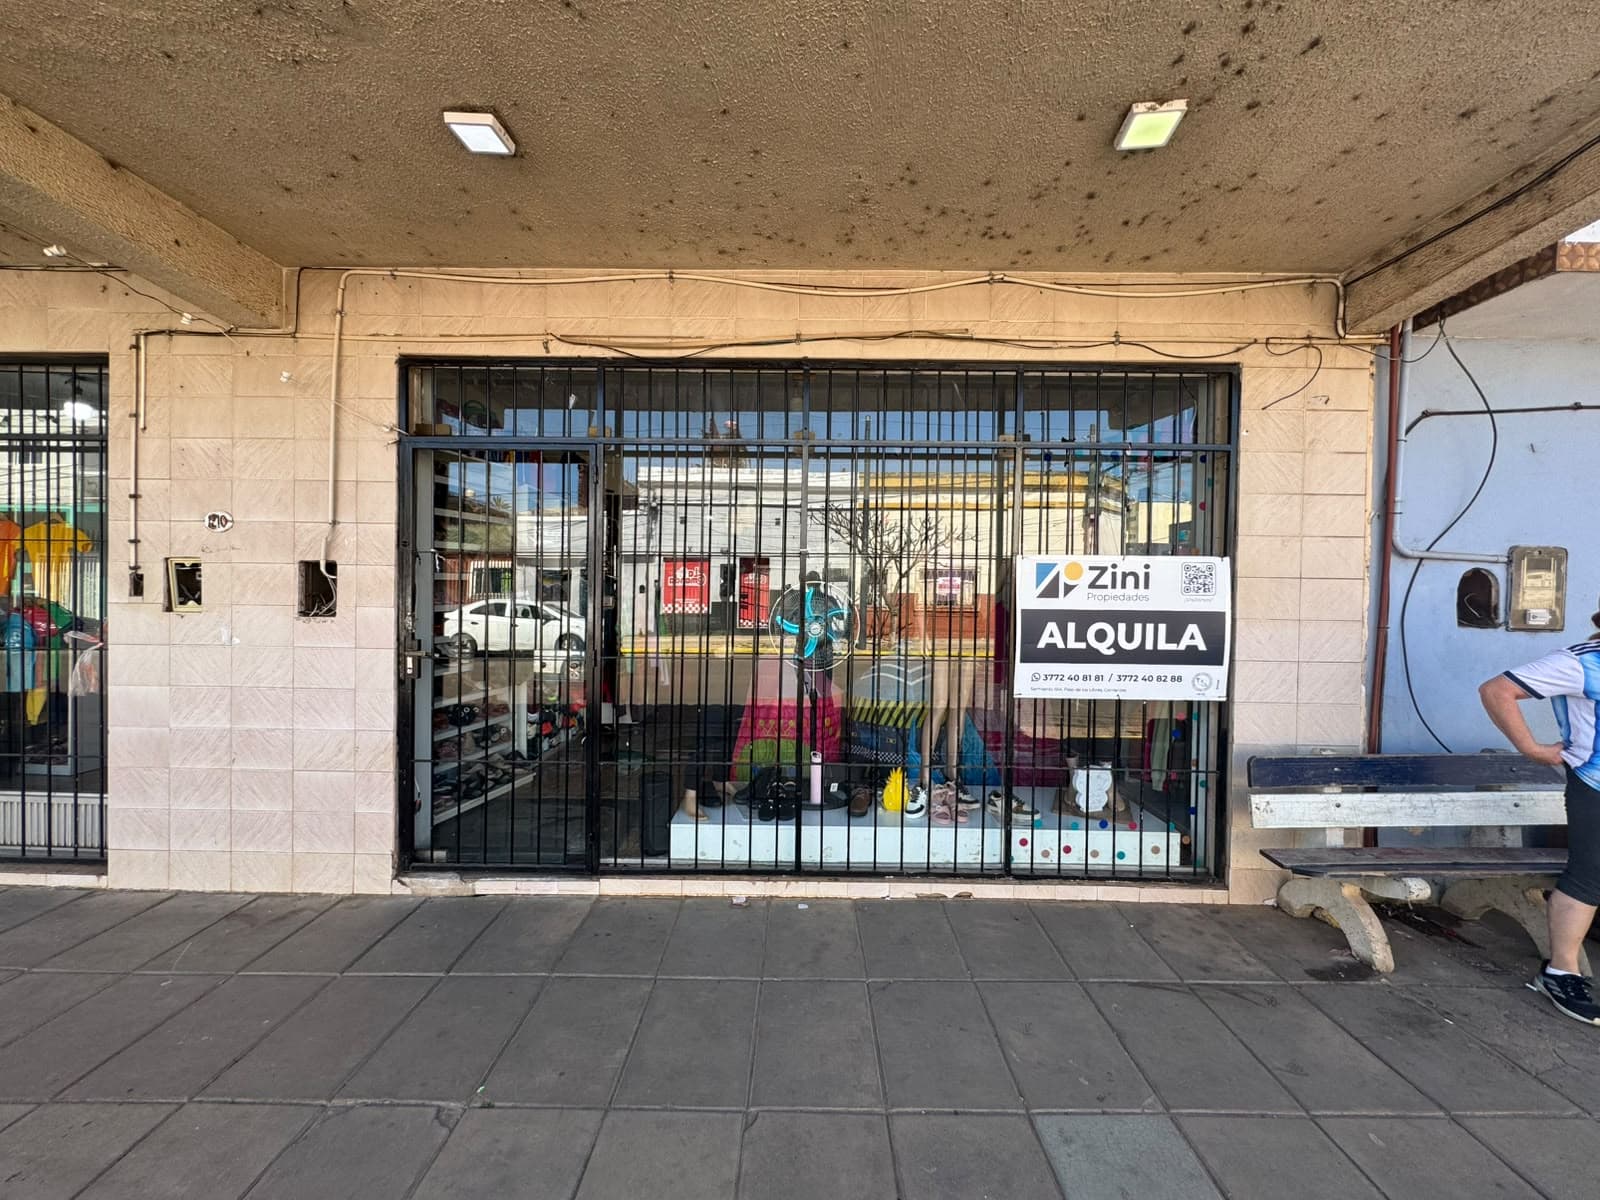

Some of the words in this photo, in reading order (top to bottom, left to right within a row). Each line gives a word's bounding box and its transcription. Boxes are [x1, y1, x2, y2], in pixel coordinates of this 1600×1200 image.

[1088, 563, 1151, 590] Zini
[1087, 592, 1150, 602] Propiedades
[1036, 621, 1207, 655] ALQUILA
[1042, 673, 1065, 681] 3772
[1067, 674, 1080, 682] 40
[1082, 674, 1092, 682] 81
[1094, 674, 1104, 682] 81
[1116, 674, 1139, 682] 3772
[1141, 674, 1154, 682] 40
[1156, 674, 1168, 683] 82
[1170, 675, 1183, 683] 88
